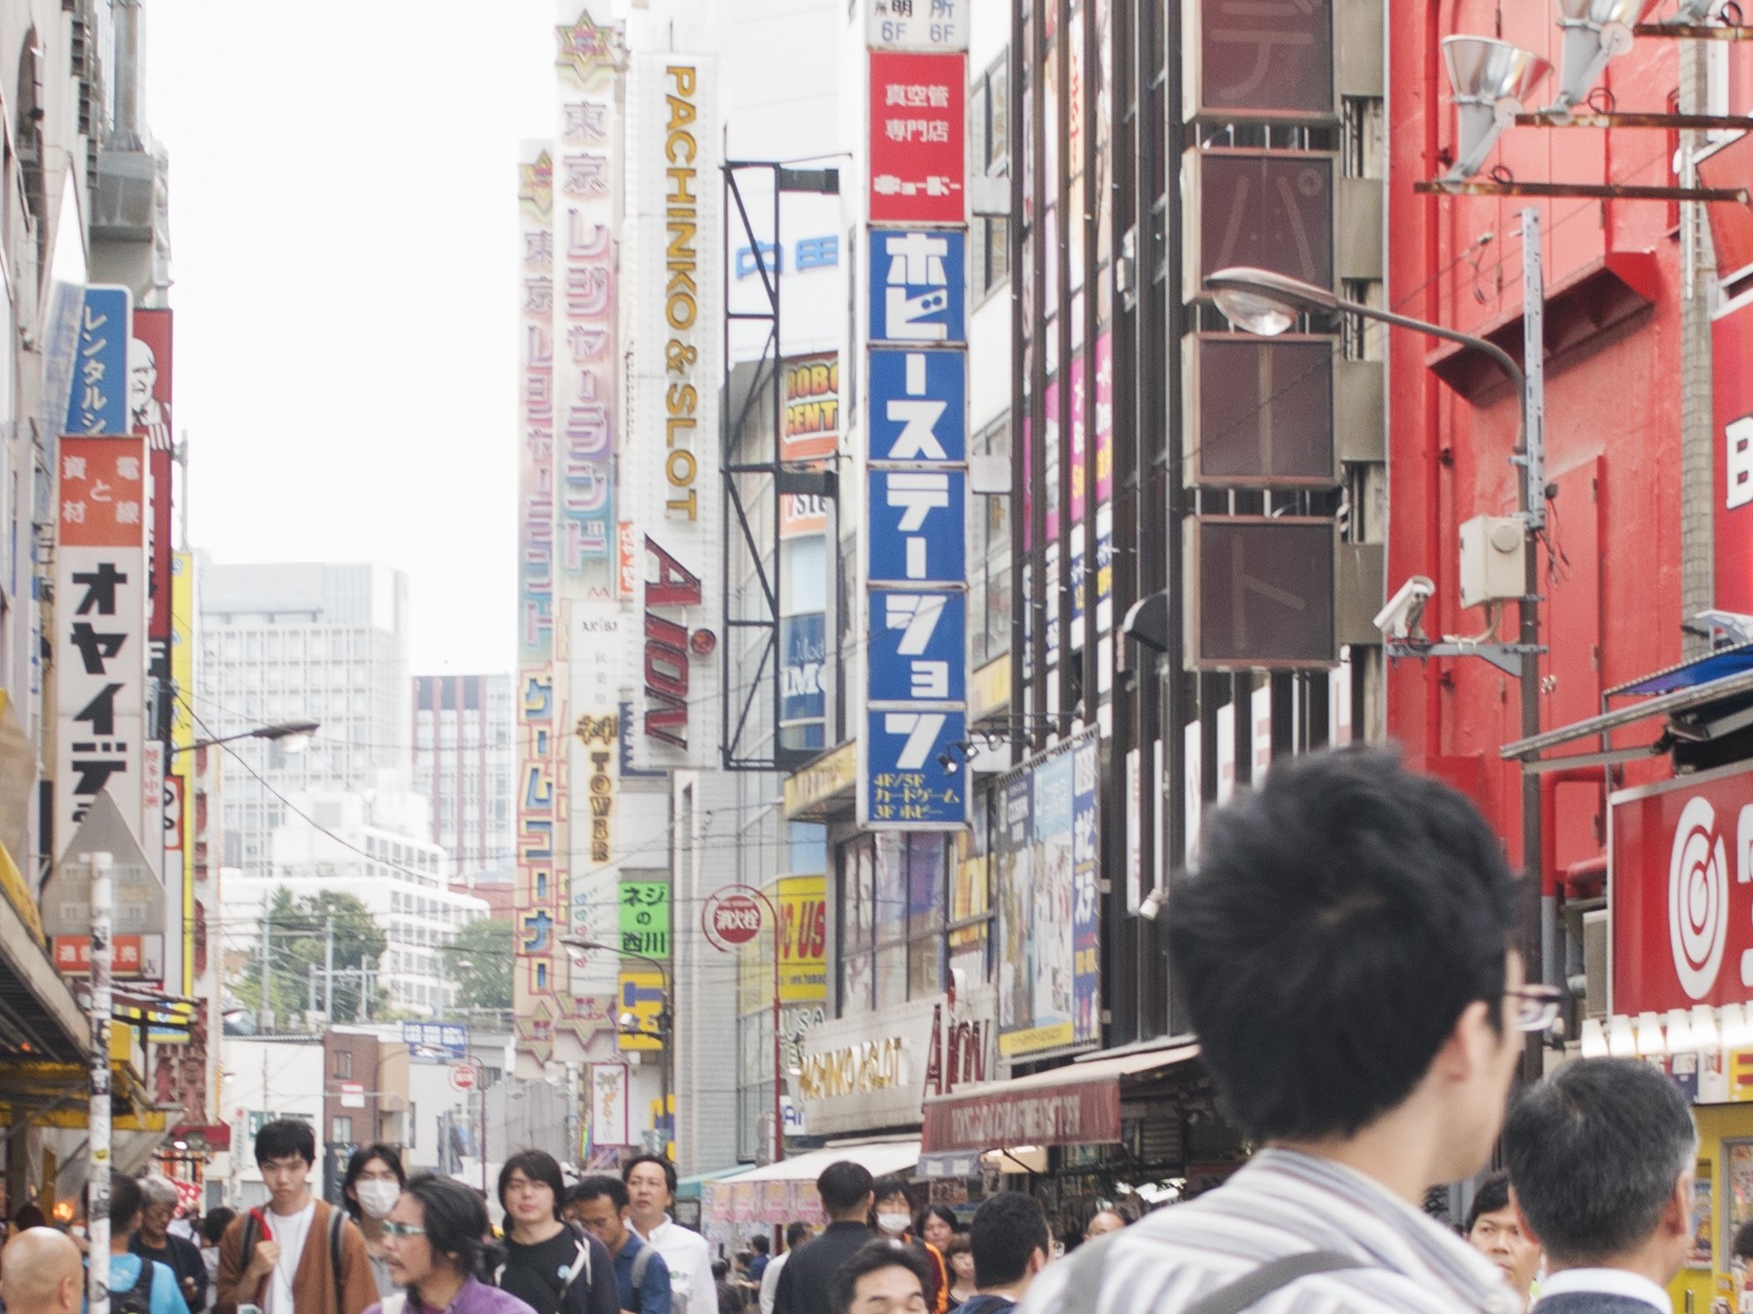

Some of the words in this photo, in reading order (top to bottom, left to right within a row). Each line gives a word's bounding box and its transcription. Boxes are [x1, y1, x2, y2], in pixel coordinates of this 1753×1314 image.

[881, 21, 907, 42] 6F
[930, 24, 955, 43] 6F
[885, 84, 949, 107] 真空管
[885, 119, 949, 142] 専門店
[665, 65, 697, 332] PACHINKO
[666, 340, 697, 370] &
[665, 383, 697, 522] SLOT
[70, 562, 128, 822] オヤイデ
[623, 886, 665, 907] ネジ
[636, 911, 651, 925] の
[716, 909, 760, 930] 消火栓
[622, 932, 666, 954] 西川
